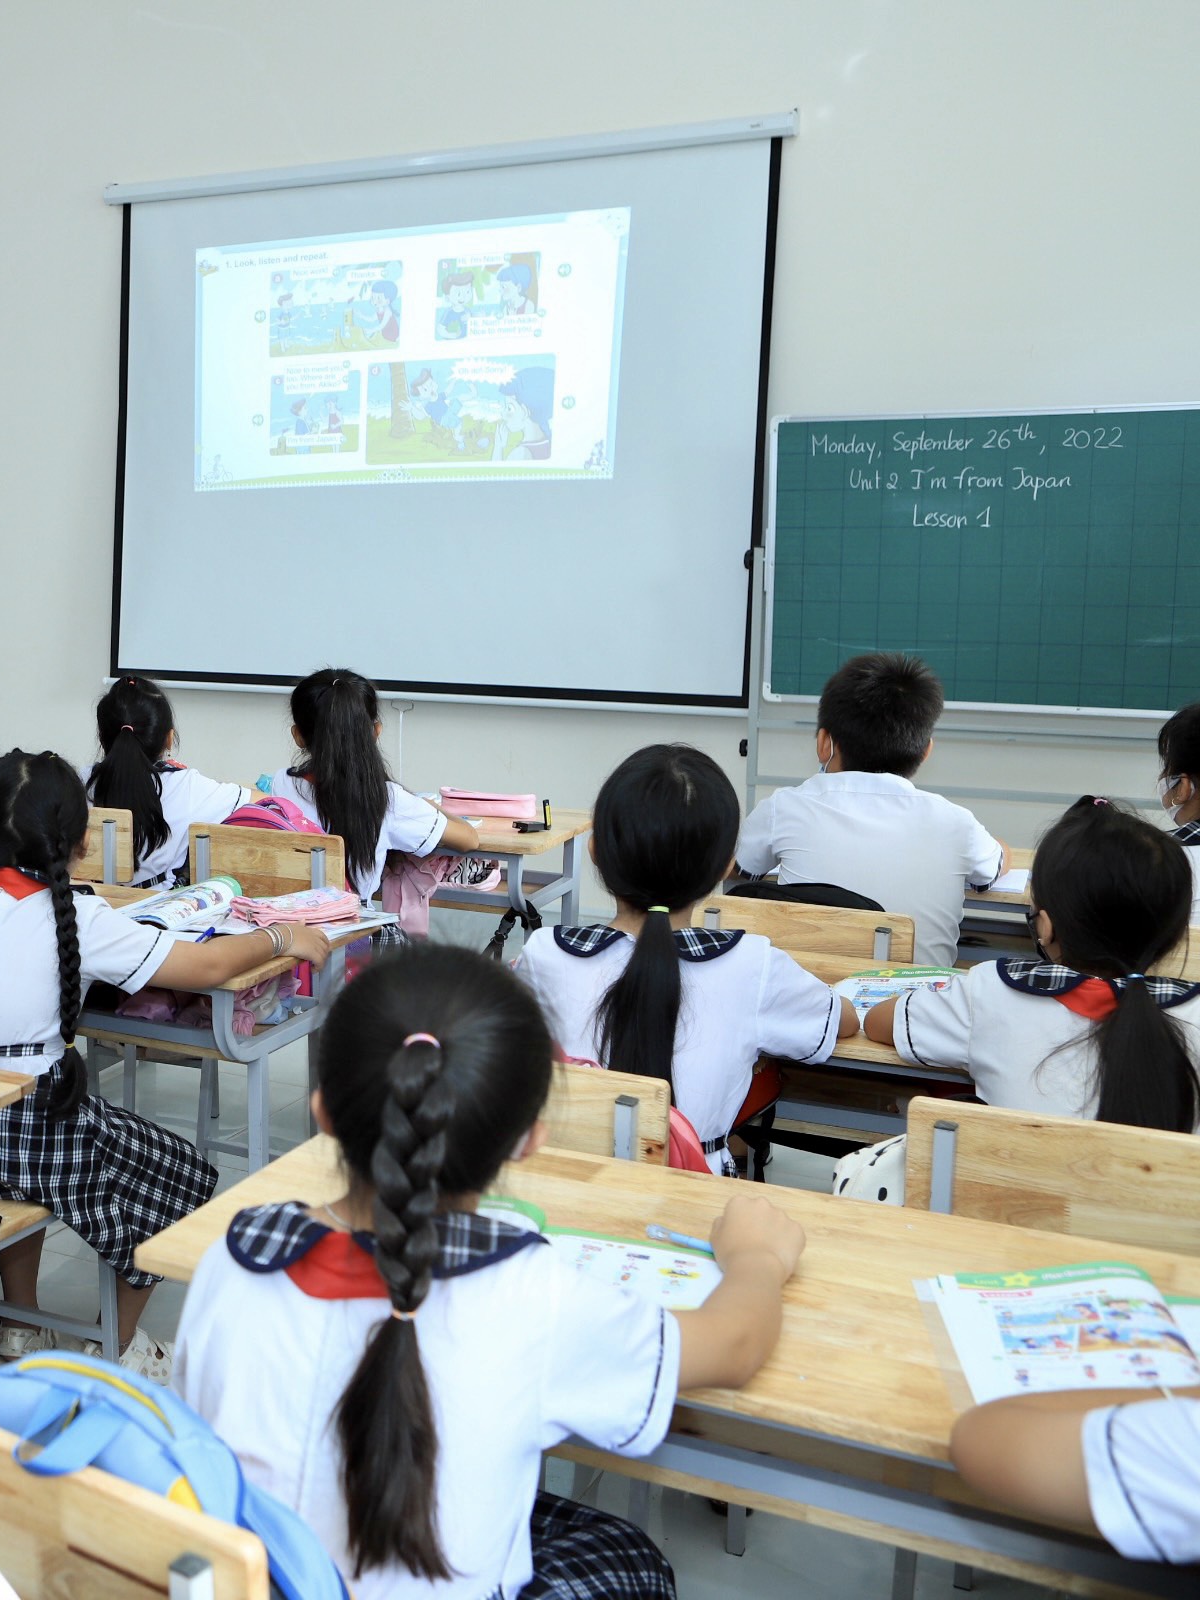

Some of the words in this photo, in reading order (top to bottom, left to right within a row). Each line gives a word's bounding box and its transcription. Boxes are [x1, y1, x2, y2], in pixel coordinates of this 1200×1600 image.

[234, 258, 256, 268] Look,
[258, 256, 281, 265] listen
[283, 253, 298, 263] and
[300, 251, 328, 263] repeat.
[812, 433, 882, 464] Monday,
[893, 429, 974, 460] September
[1062, 426, 1124, 449] 2022
[850, 469, 881, 490] Unit
[886, 472, 898, 490] 2
[911, 466, 946, 490] I'm
[953, 466, 1003, 490] from
[1012, 466, 1071, 501] Japan
[913, 504, 967, 528] Lesson
[976, 506, 991, 528] 1
